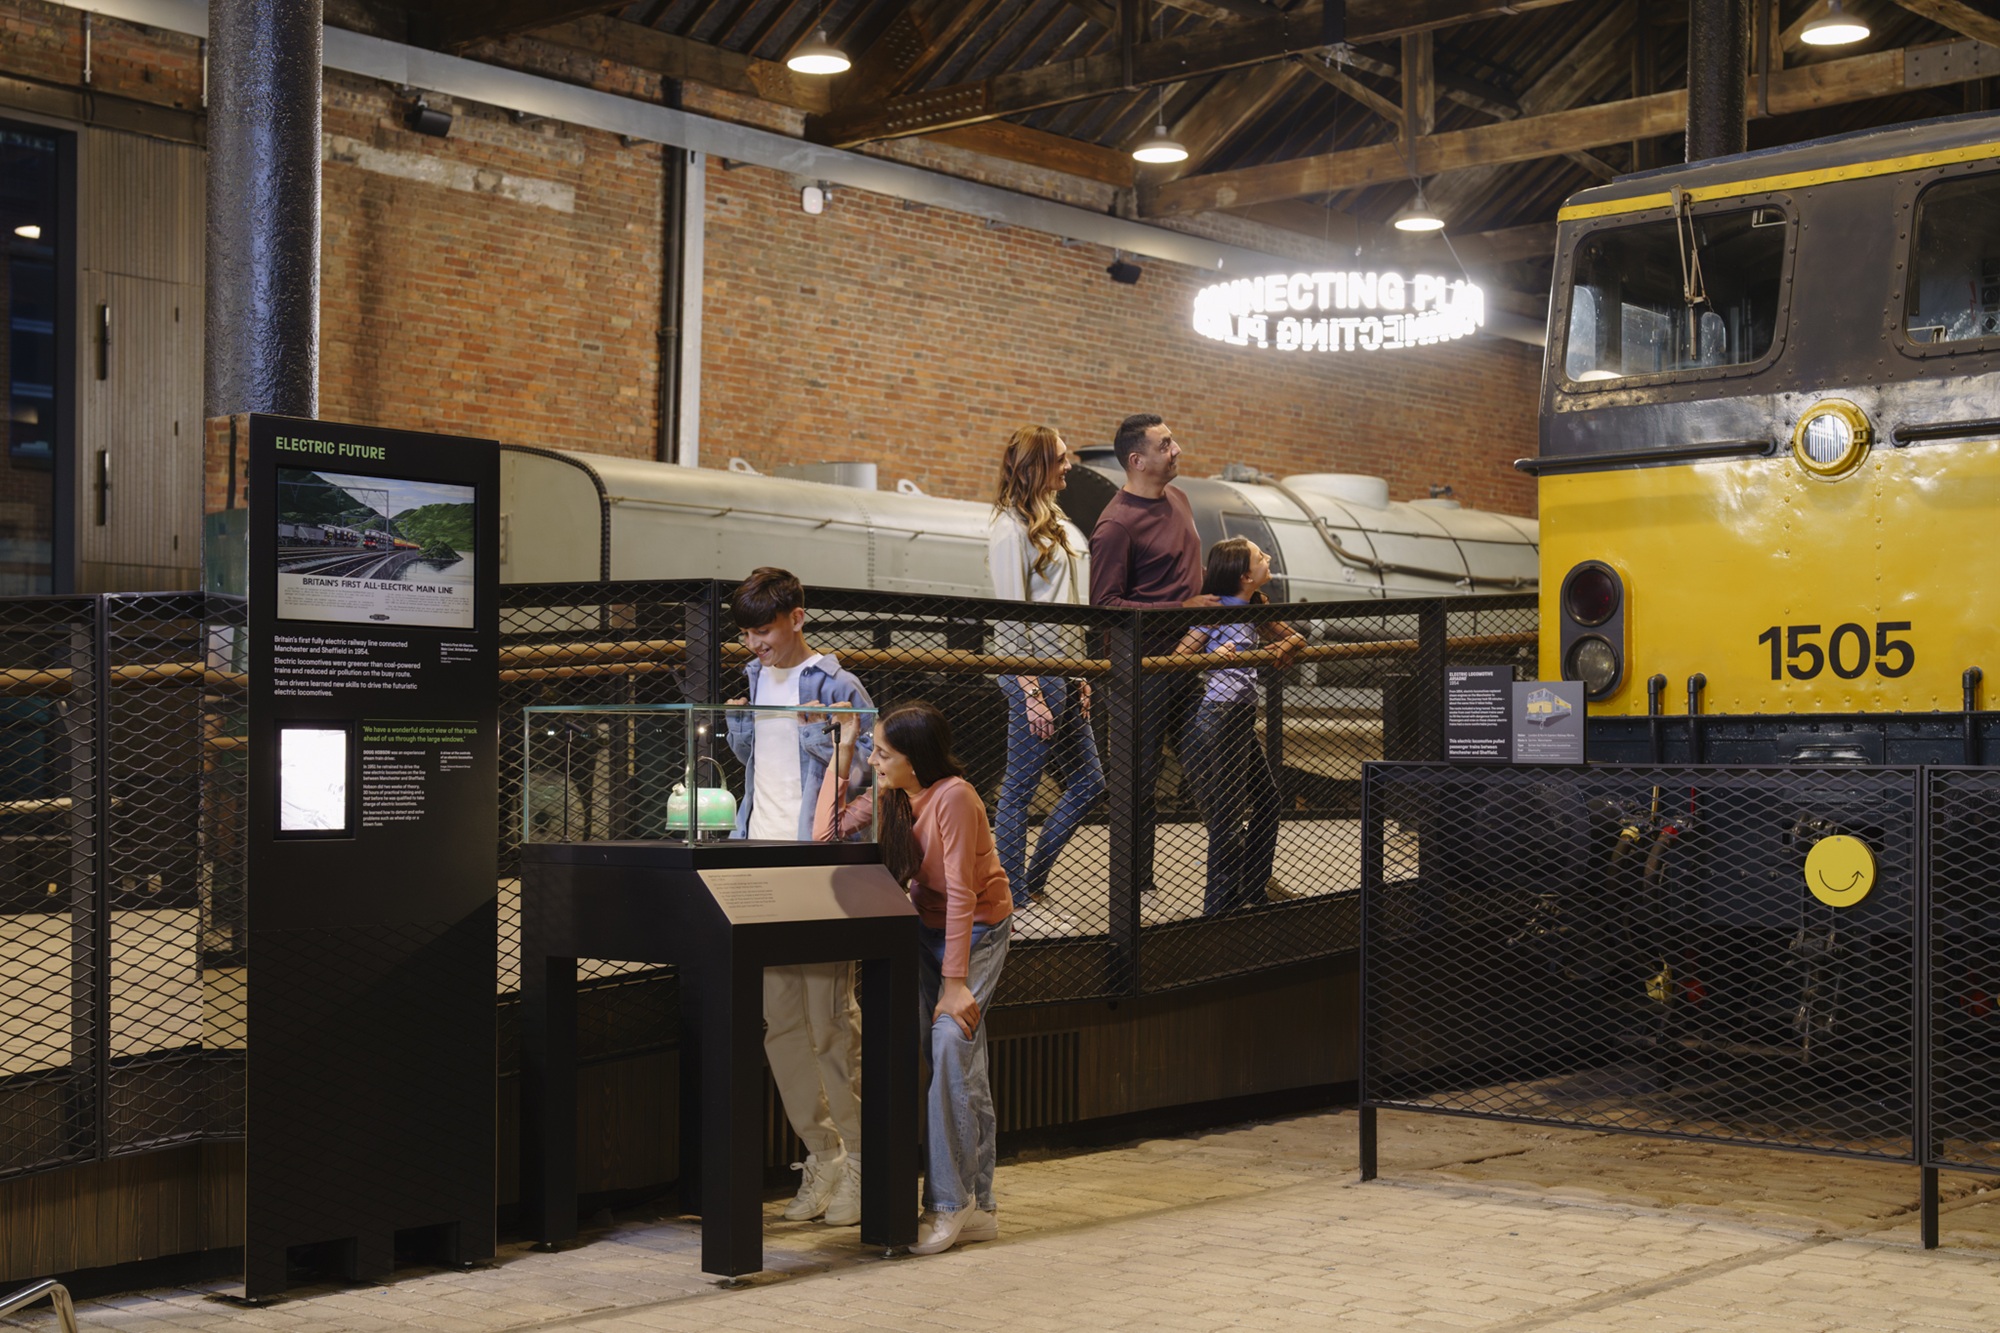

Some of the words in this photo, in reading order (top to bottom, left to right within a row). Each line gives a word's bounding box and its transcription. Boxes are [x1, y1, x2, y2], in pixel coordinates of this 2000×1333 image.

[275, 436, 335, 455] ELECTRIC
[338, 443, 386, 460] FUTURE
[303, 578, 338, 587] BRITAIN'S
[342, 580, 361, 588] FIRST
[364, 581, 413, 592] ALL-ELECTRIC
[416, 585, 435, 593] MAIN
[438, 586, 453, 594] LINE
[312, 637, 324, 646] fully
[348, 639, 366, 647] railway
[1758, 621, 1915, 680] 1505
[298, 658, 331, 666] locomotives
[384, 661, 420, 669] coal-powered
[338, 669, 361, 677] pollution
[382, 670, 394, 678] busy
